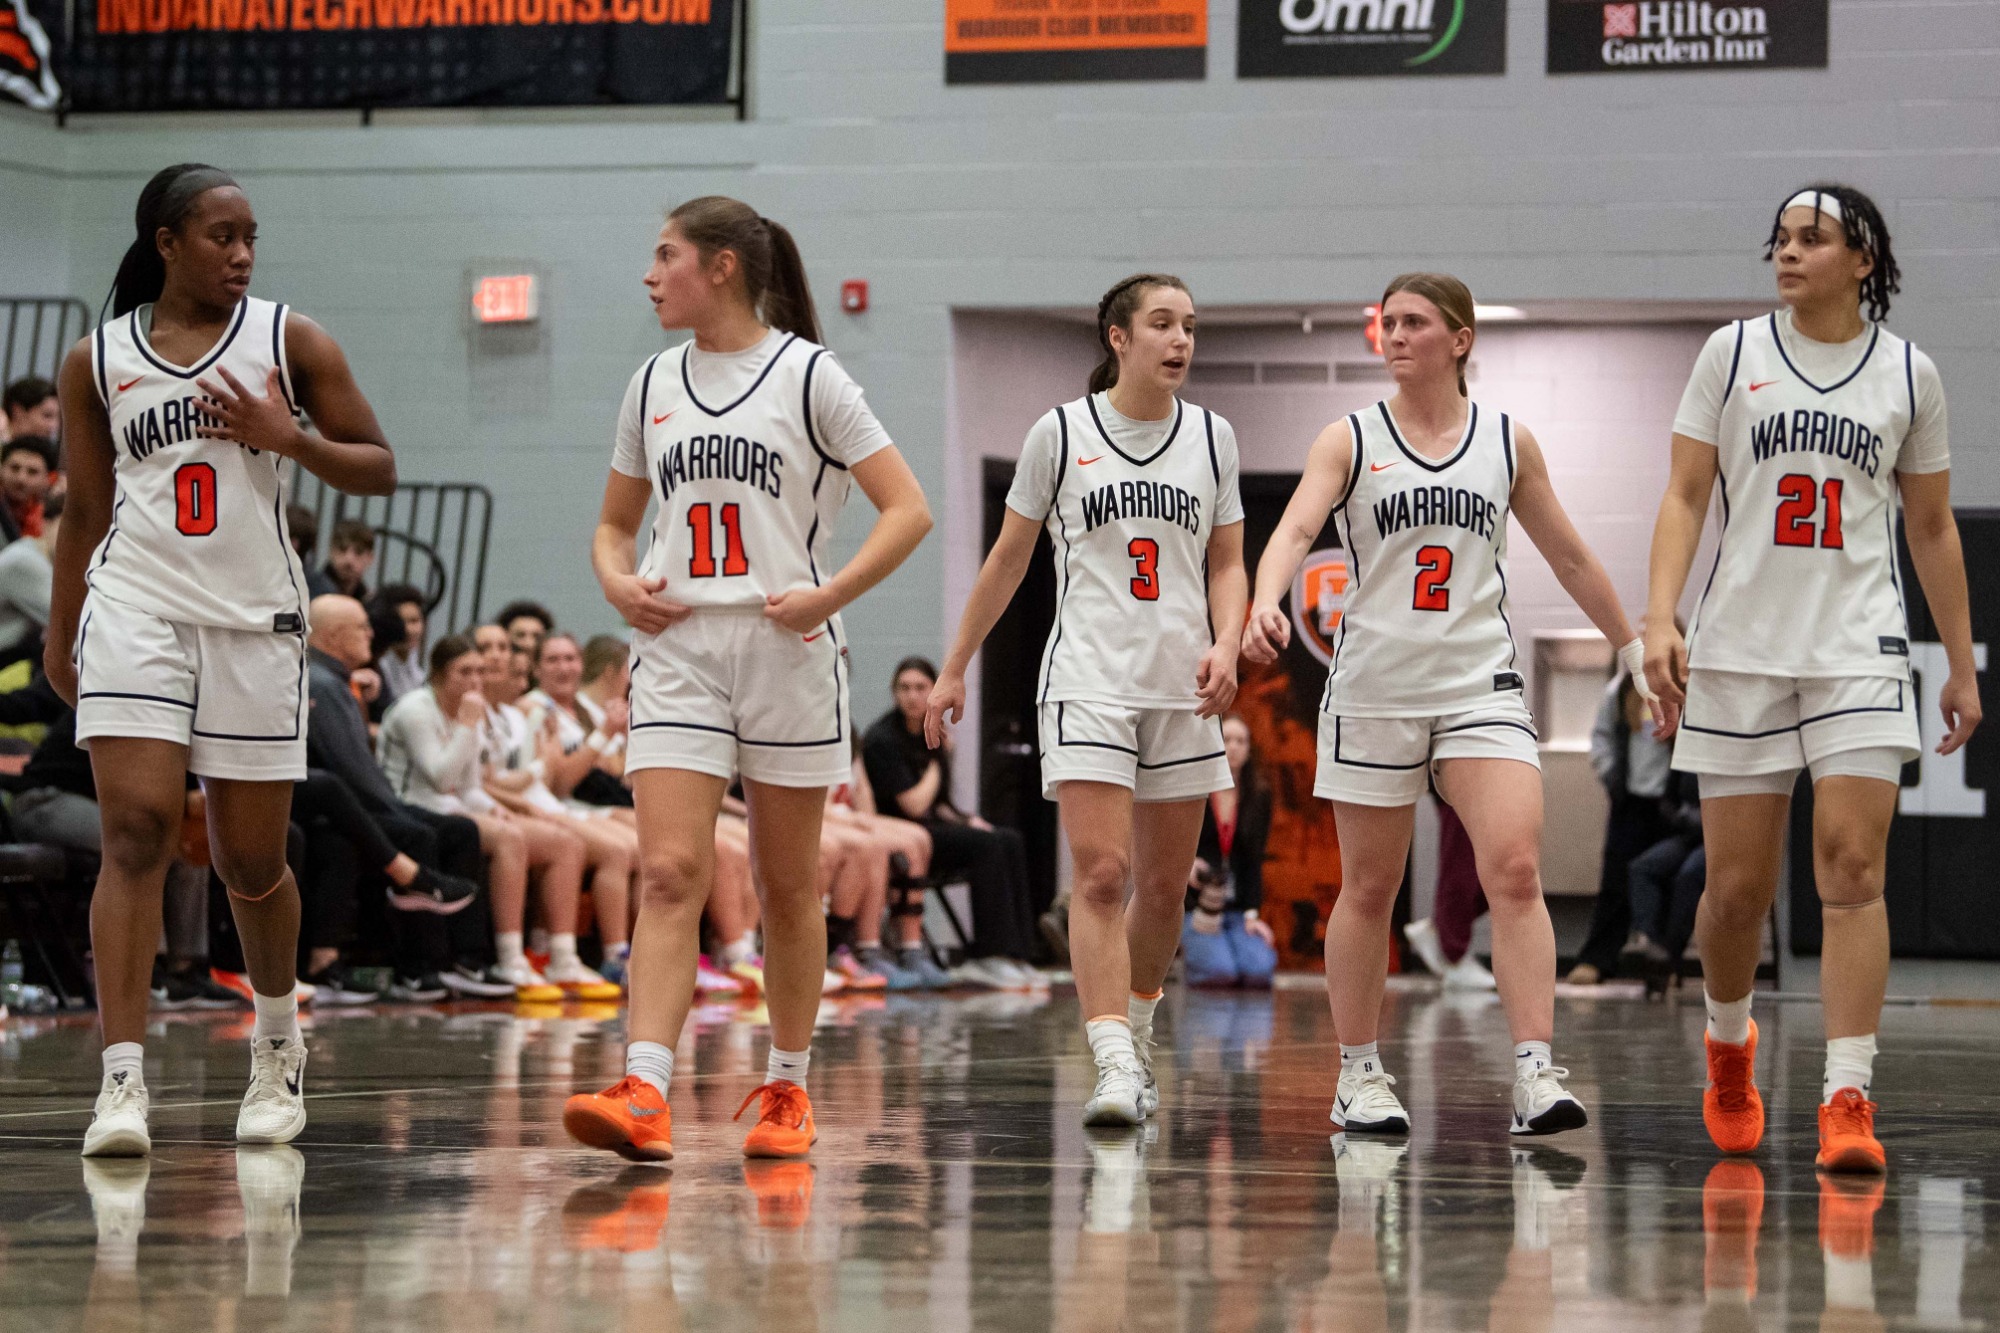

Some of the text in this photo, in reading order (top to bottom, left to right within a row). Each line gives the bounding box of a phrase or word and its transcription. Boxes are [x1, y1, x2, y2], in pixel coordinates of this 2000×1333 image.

[1602, 36, 1766, 65] Garden Inn
[1638, 1, 1768, 36] Hilton
[658, 434, 784, 501] WARRIORS
[1751, 409, 1884, 480] WARRIORS
[174, 462, 217, 536] 0
[1081, 480, 1202, 536] WARRIORS
[1373, 486, 1498, 543] WARRIORS
[1774, 473, 1844, 550] 21
[687, 502, 749, 578] 11
[1128, 537, 1160, 601] 3
[1412, 544, 1454, 612] 2
